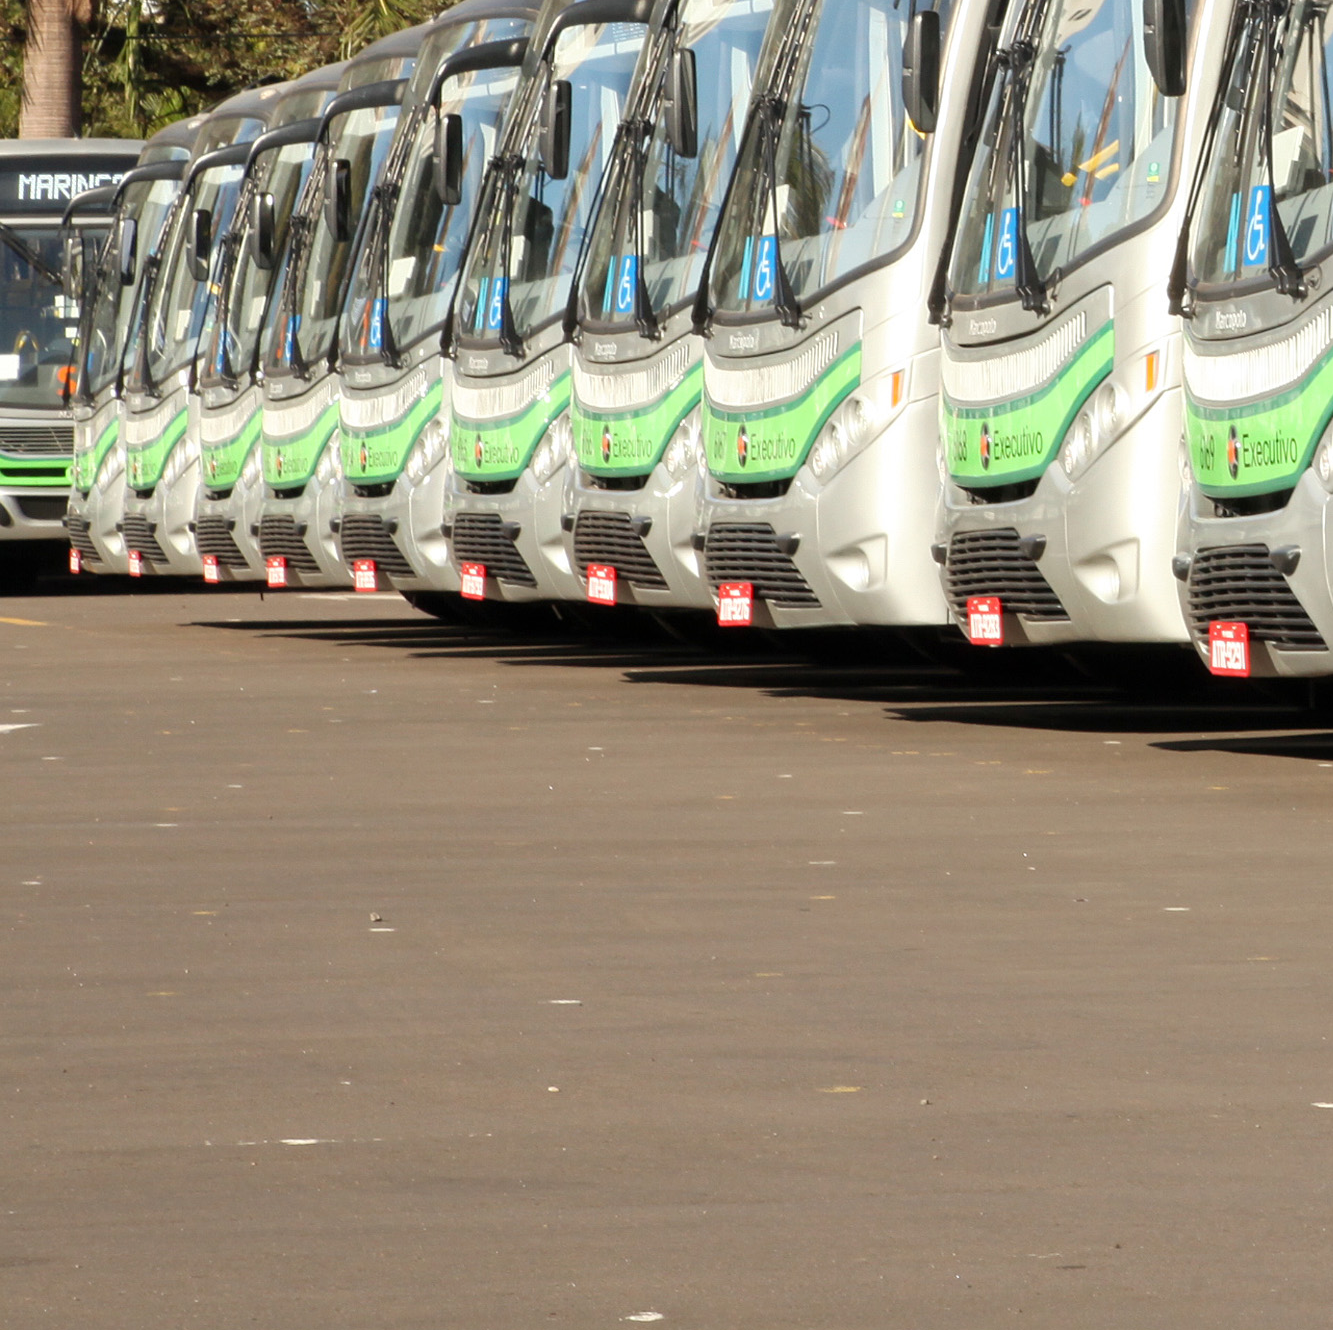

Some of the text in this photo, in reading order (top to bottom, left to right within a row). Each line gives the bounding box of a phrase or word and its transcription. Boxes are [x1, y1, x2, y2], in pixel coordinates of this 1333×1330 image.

[1215, 309, 1247, 331] Marcopolo
[750, 431, 796, 461] Executivo
[993, 425, 1043, 461] Executivo
[1242, 429, 1298, 468] Executivo
